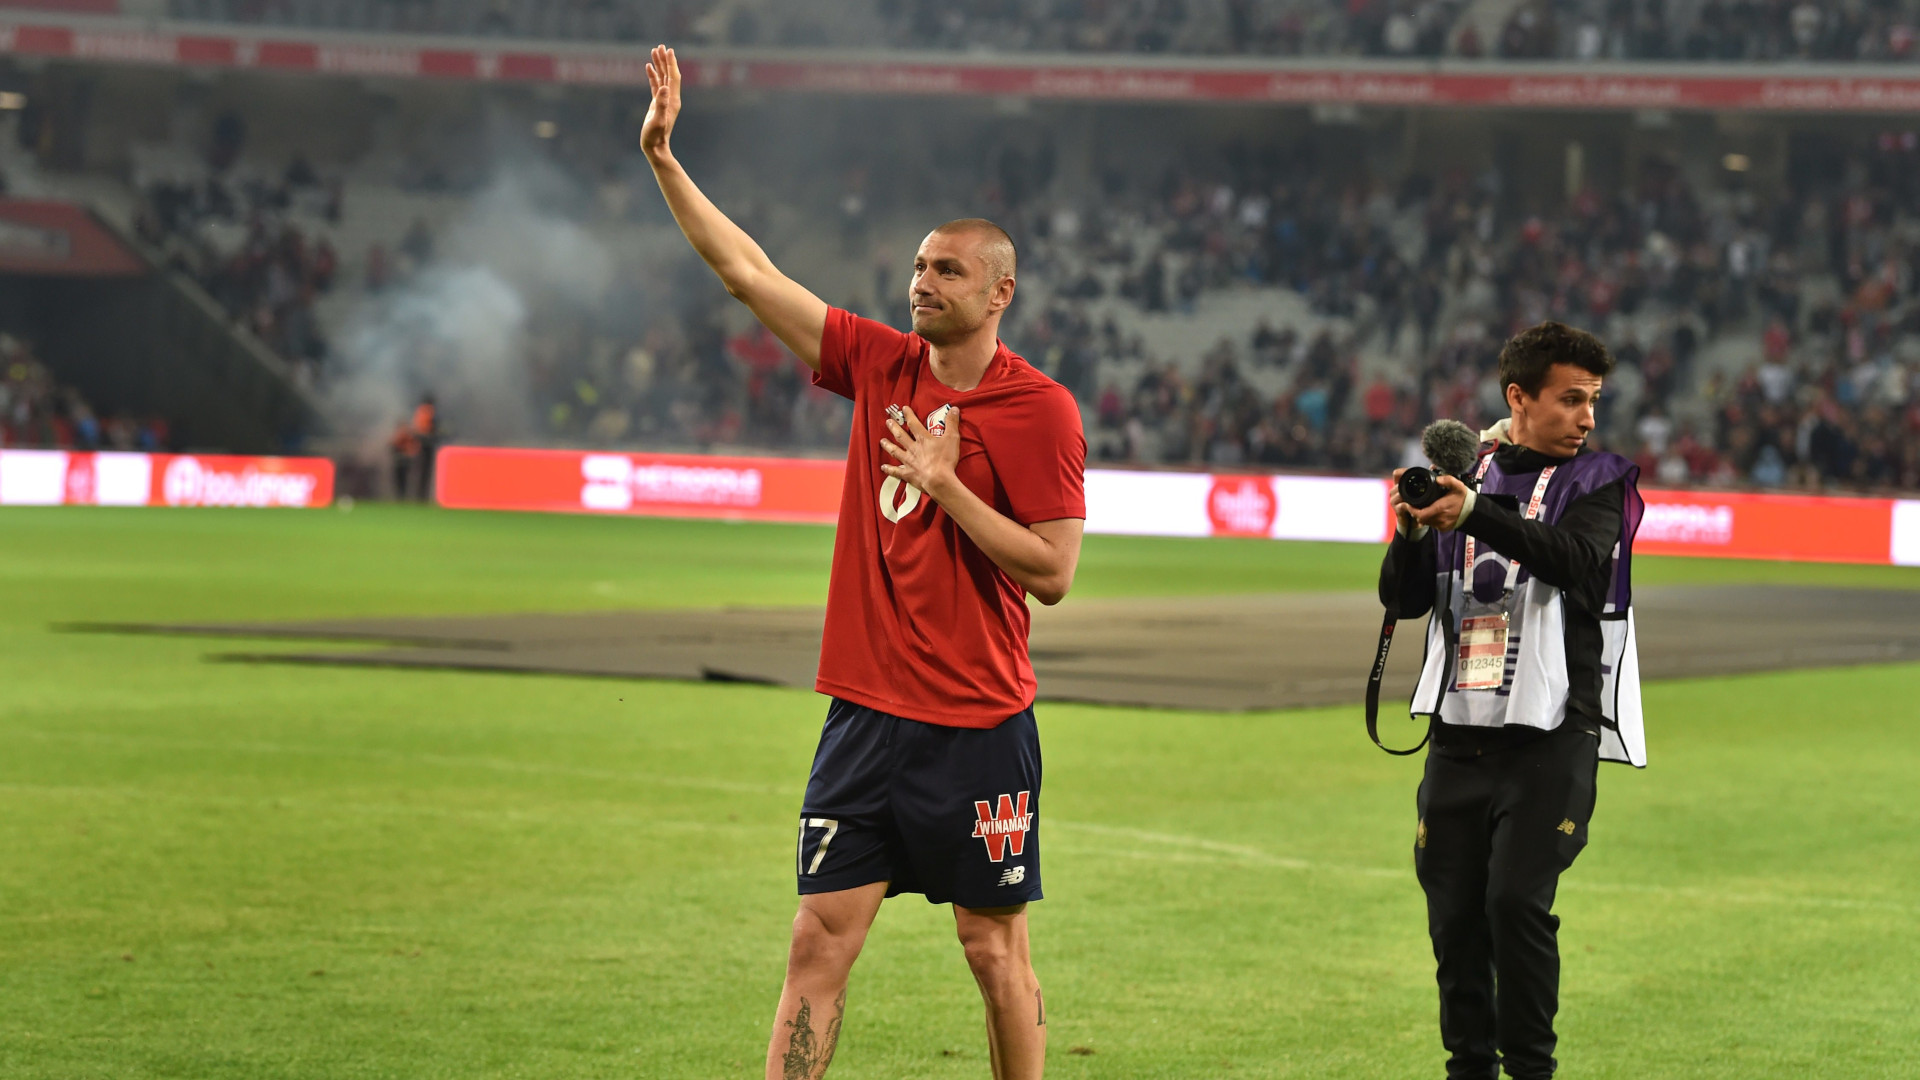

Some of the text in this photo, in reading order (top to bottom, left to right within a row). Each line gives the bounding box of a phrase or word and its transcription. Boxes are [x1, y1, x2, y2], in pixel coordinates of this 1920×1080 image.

[1541, 466, 1554, 480] LOS
[1466, 542, 1474, 568] LOSC
[1372, 638, 1391, 681] LUMIX
[1461, 658, 1503, 671] 012345
[980, 816, 1028, 835] WINAMAX
